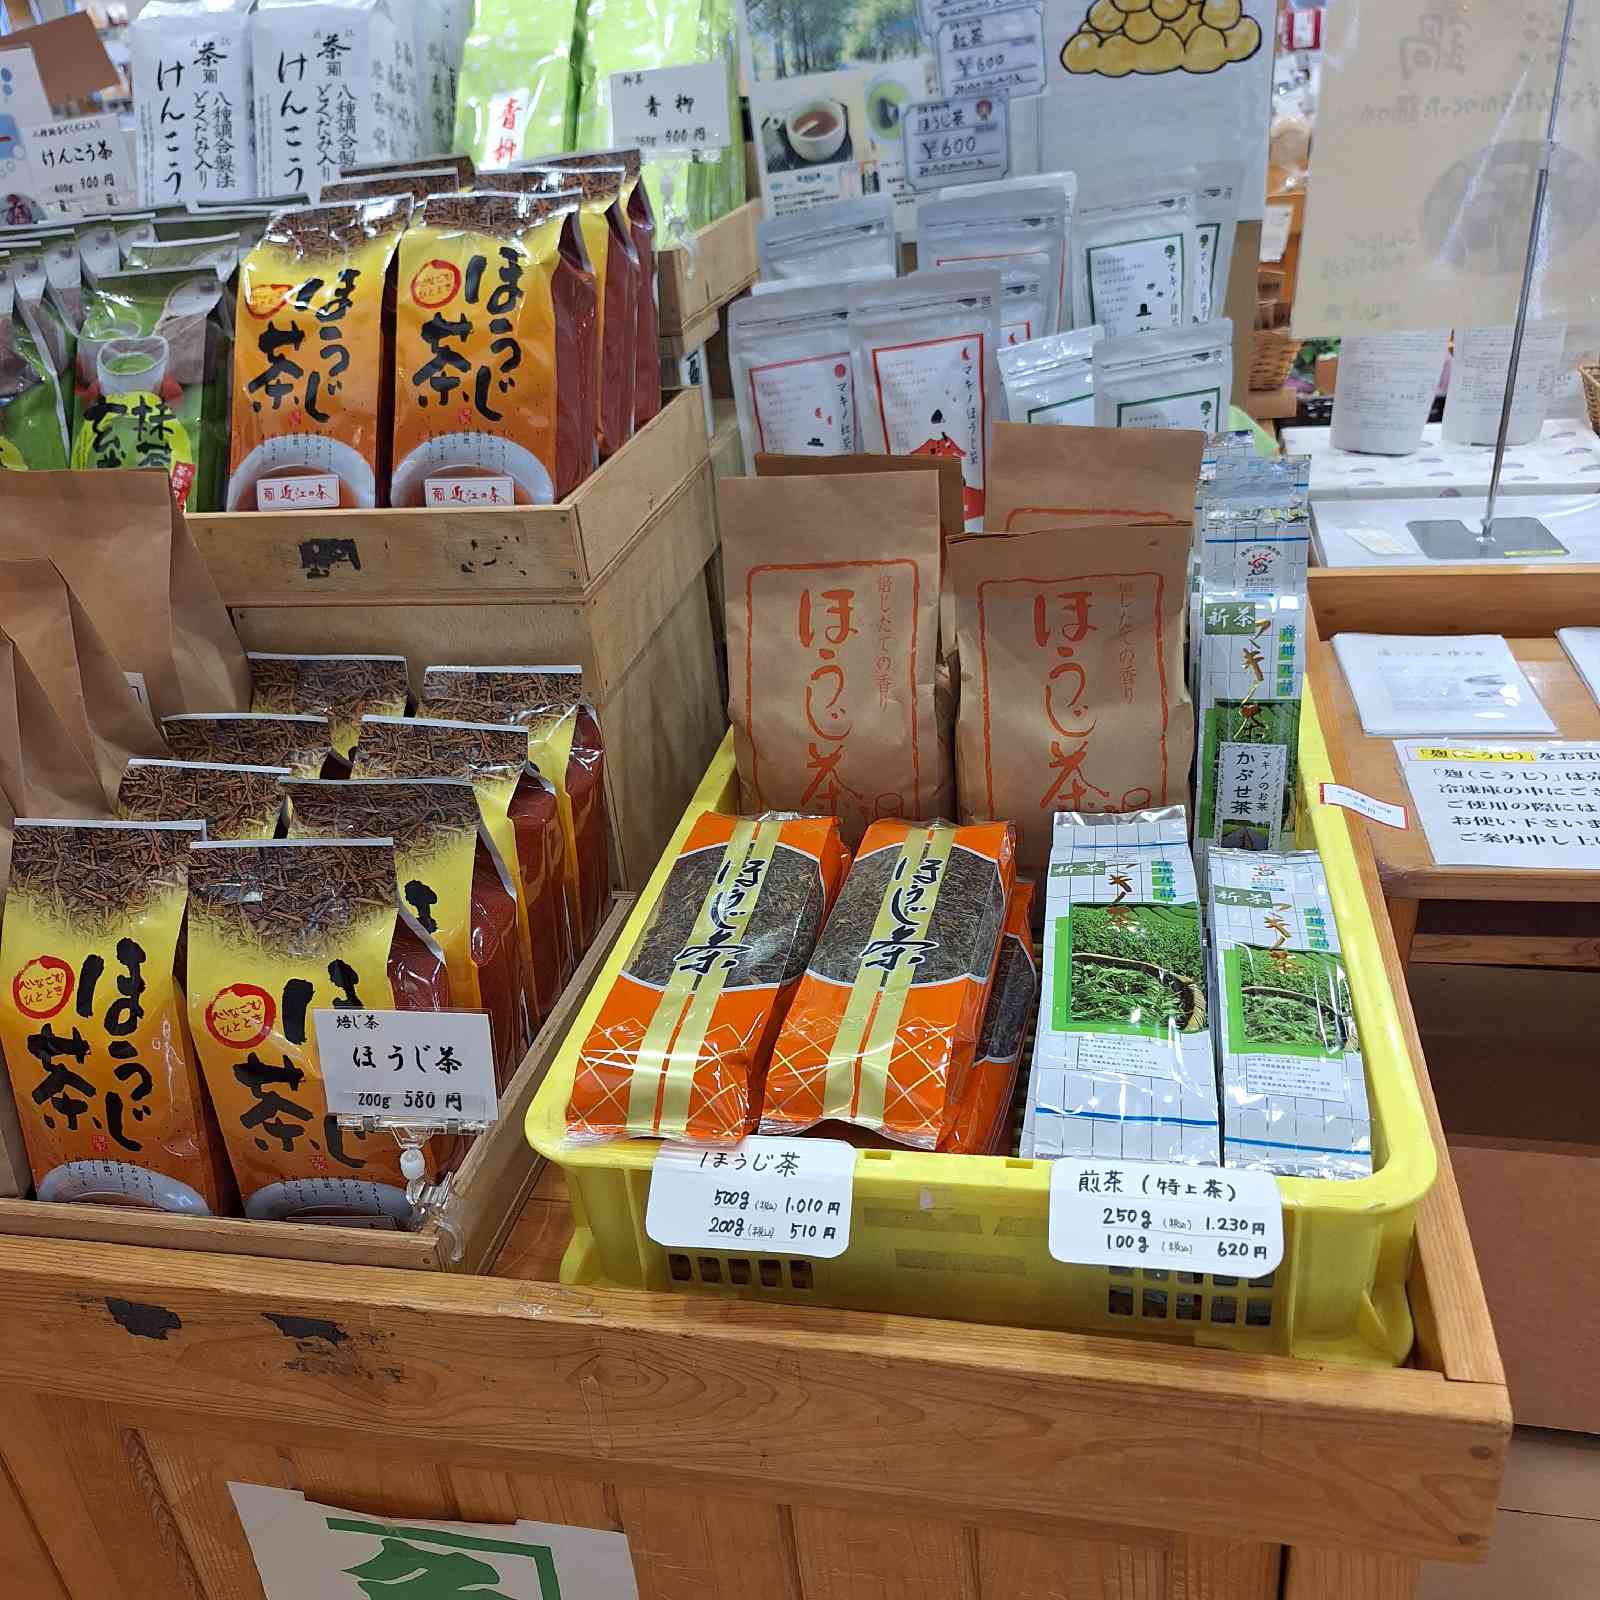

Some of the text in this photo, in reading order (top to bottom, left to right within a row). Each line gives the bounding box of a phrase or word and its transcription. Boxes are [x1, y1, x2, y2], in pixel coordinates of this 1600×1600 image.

[193, 42, 228, 66] 茶
[317, 34, 351, 59] 茶
[645, 94, 695, 117] 青柳
[158, 59, 185, 195] けんこう
[278, 52, 308, 191] けんこう
[494, 97, 522, 162] 青柳
[42, 139, 113, 168] けんこう茶
[194, 91, 213, 190] どくだみ入り
[922, 136, 976, 160] ¥600
[413, 247, 524, 422] ほうじ茶
[1207, 608, 1254, 628] 新茶
[799, 589, 866, 818] ほうじ茶
[1034, 590, 1110, 811] ほうじ茶
[1231, 751, 1255, 815] かぶせ茶
[1256, 751, 1272, 812] マキノのお茶
[1448, 800, 1598, 812] ご使用の際には
[1055, 862, 1104, 875] 新茶
[1217, 891, 1271, 905] 新茶
[673, 858, 767, 974] ほうじ茶
[858, 857, 943, 972] ほうじ茶
[337, 1015, 380, 1030] 焙じ茶
[27, 937, 153, 1152] ほうじ茶
[353, 1045, 462, 1074] ほうじ茶
[358, 1093, 391, 1109] 200g
[700, 1151, 800, 1177] ほうじ茶
[714, 1189, 750, 1209] 500g
[708, 1216, 745, 1236] 200g
[1103, 1207, 1152, 1229] 250g
[1106, 1233, 1150, 1253] 100g
